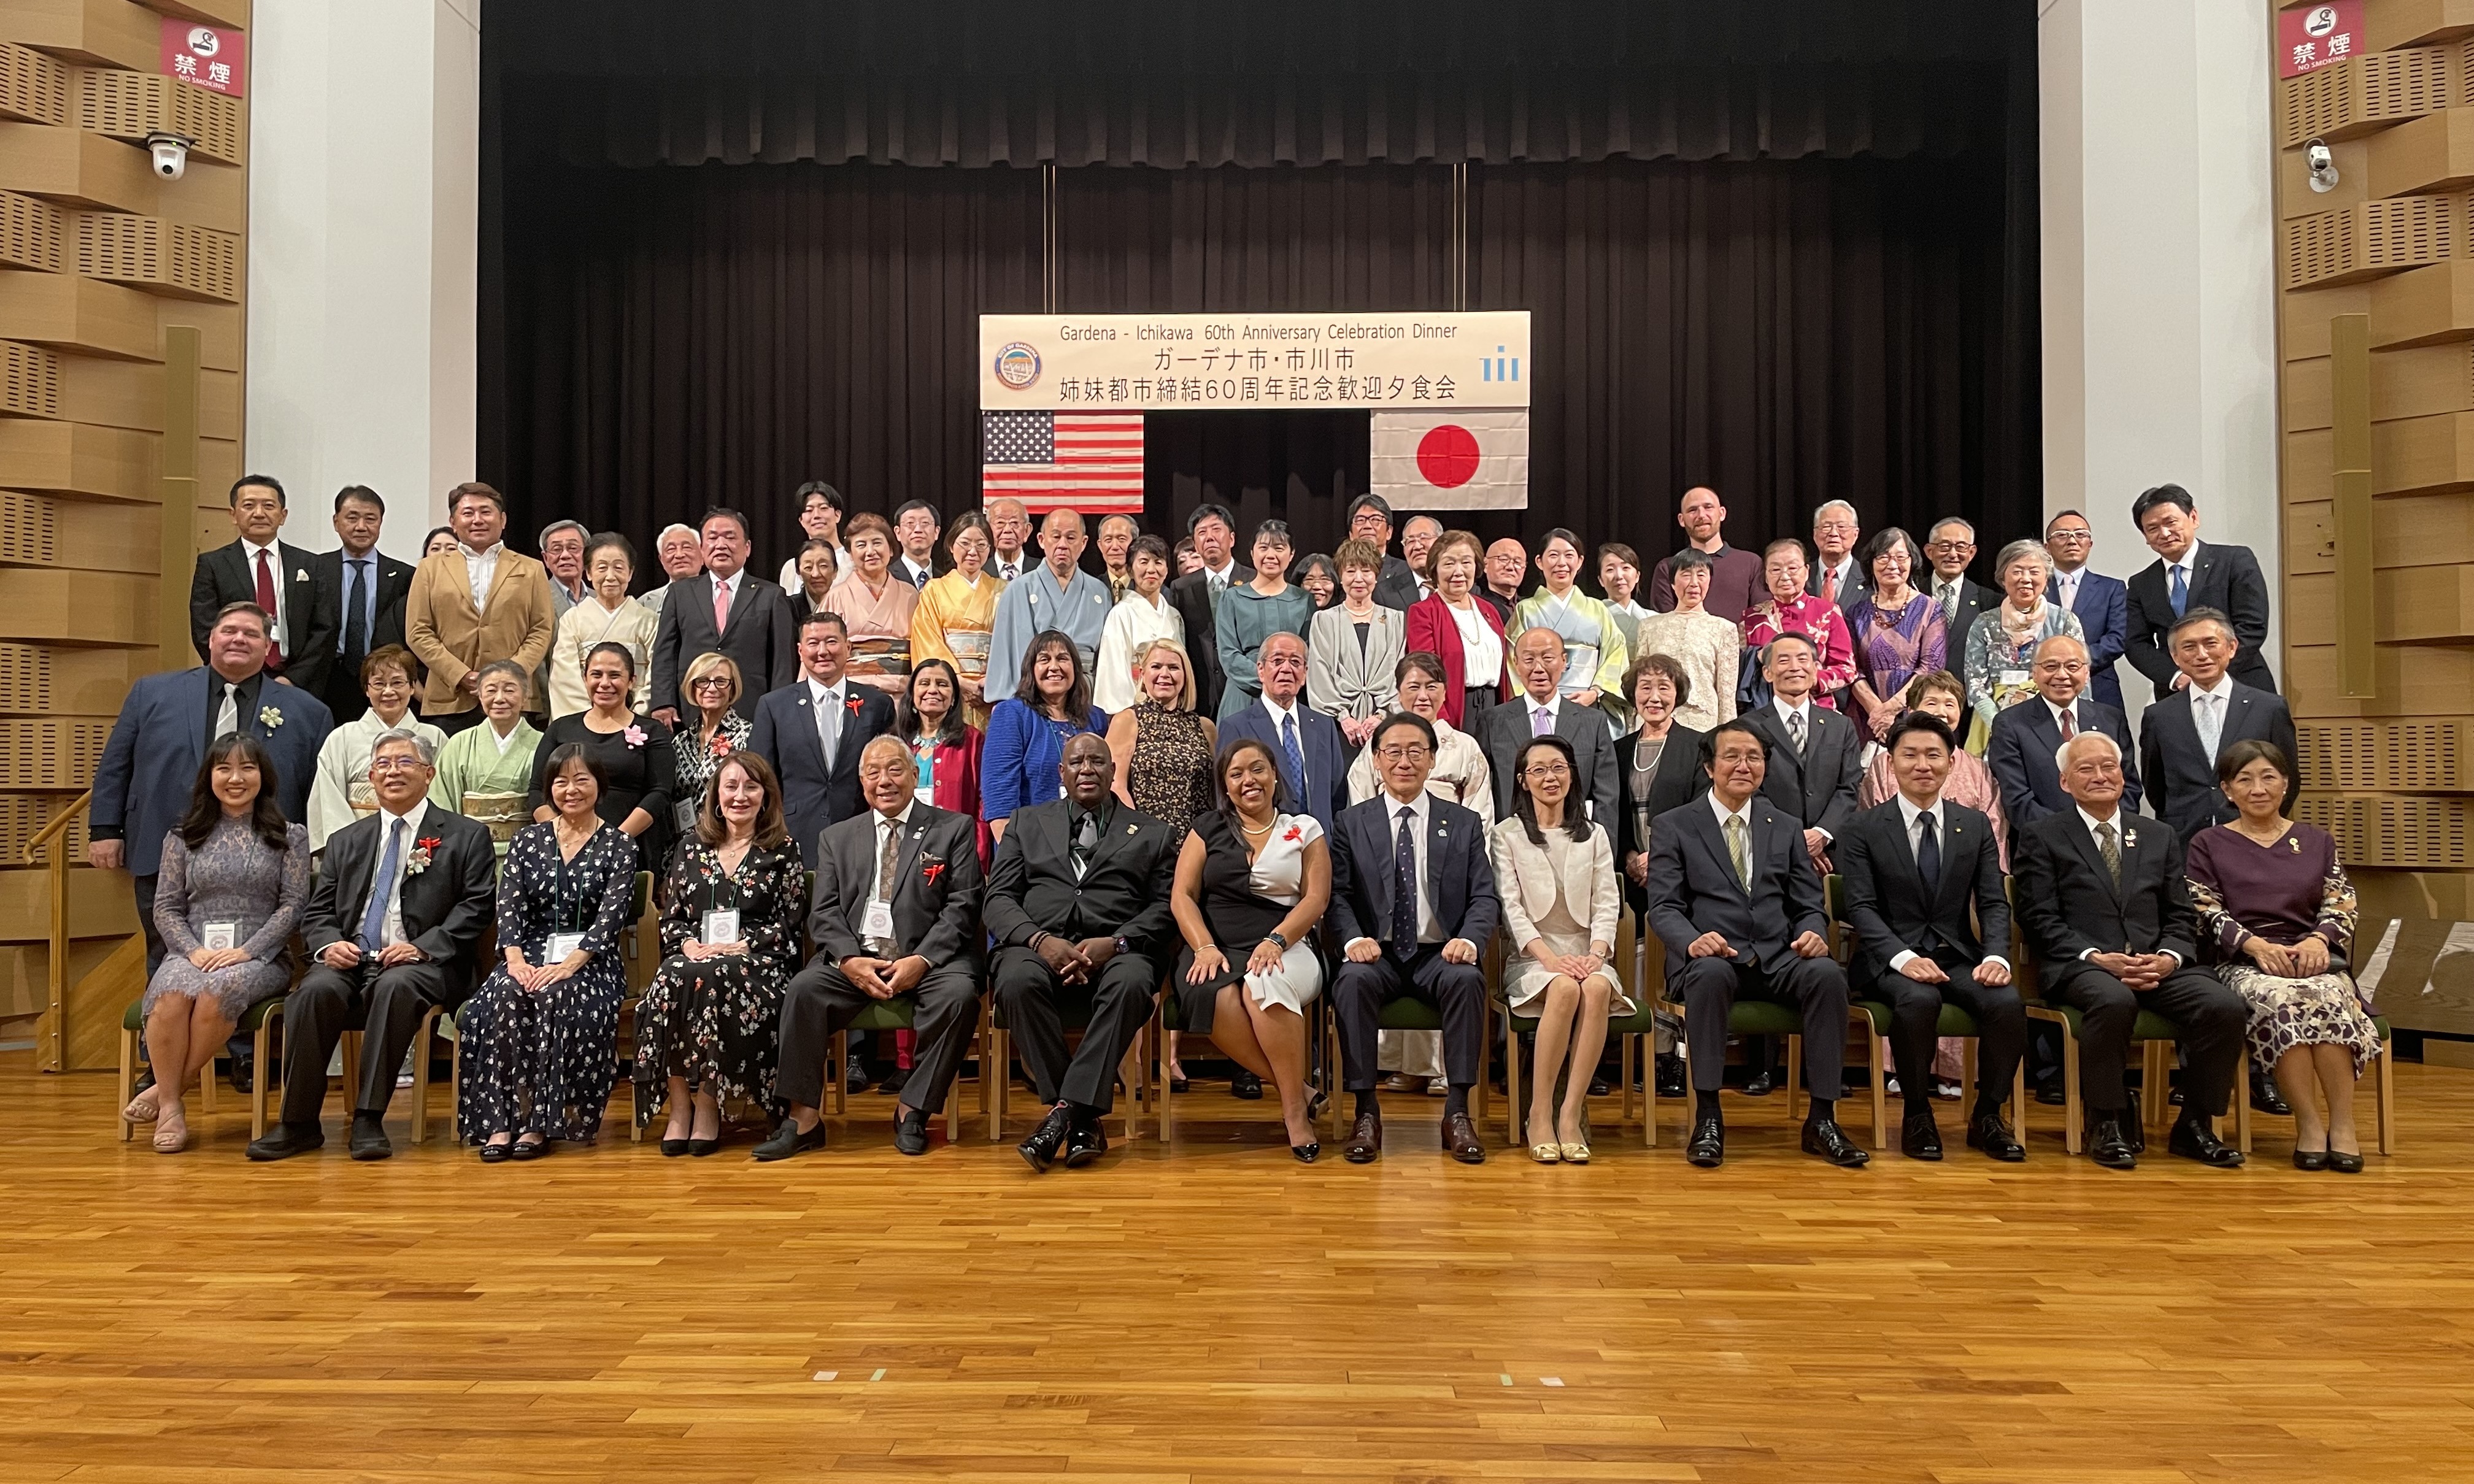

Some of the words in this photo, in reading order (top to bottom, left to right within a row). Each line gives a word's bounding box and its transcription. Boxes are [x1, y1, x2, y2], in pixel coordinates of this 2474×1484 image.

[2311, 55, 2346, 67] SMOKING
[192, 77, 226, 90] SMOKING
[1060, 325, 1116, 340] Gardena
[1137, 324, 1193, 340] Ichikawa
[1204, 324, 1235, 340] 60th
[1242, 324, 1321, 344] Anniversary
[1328, 323, 1405, 339] Celebration
[1413, 323, 1458, 339] Dinner
[1060, 375, 1456, 402] 姉妹都市締結60周年記念歓迎夕食会
